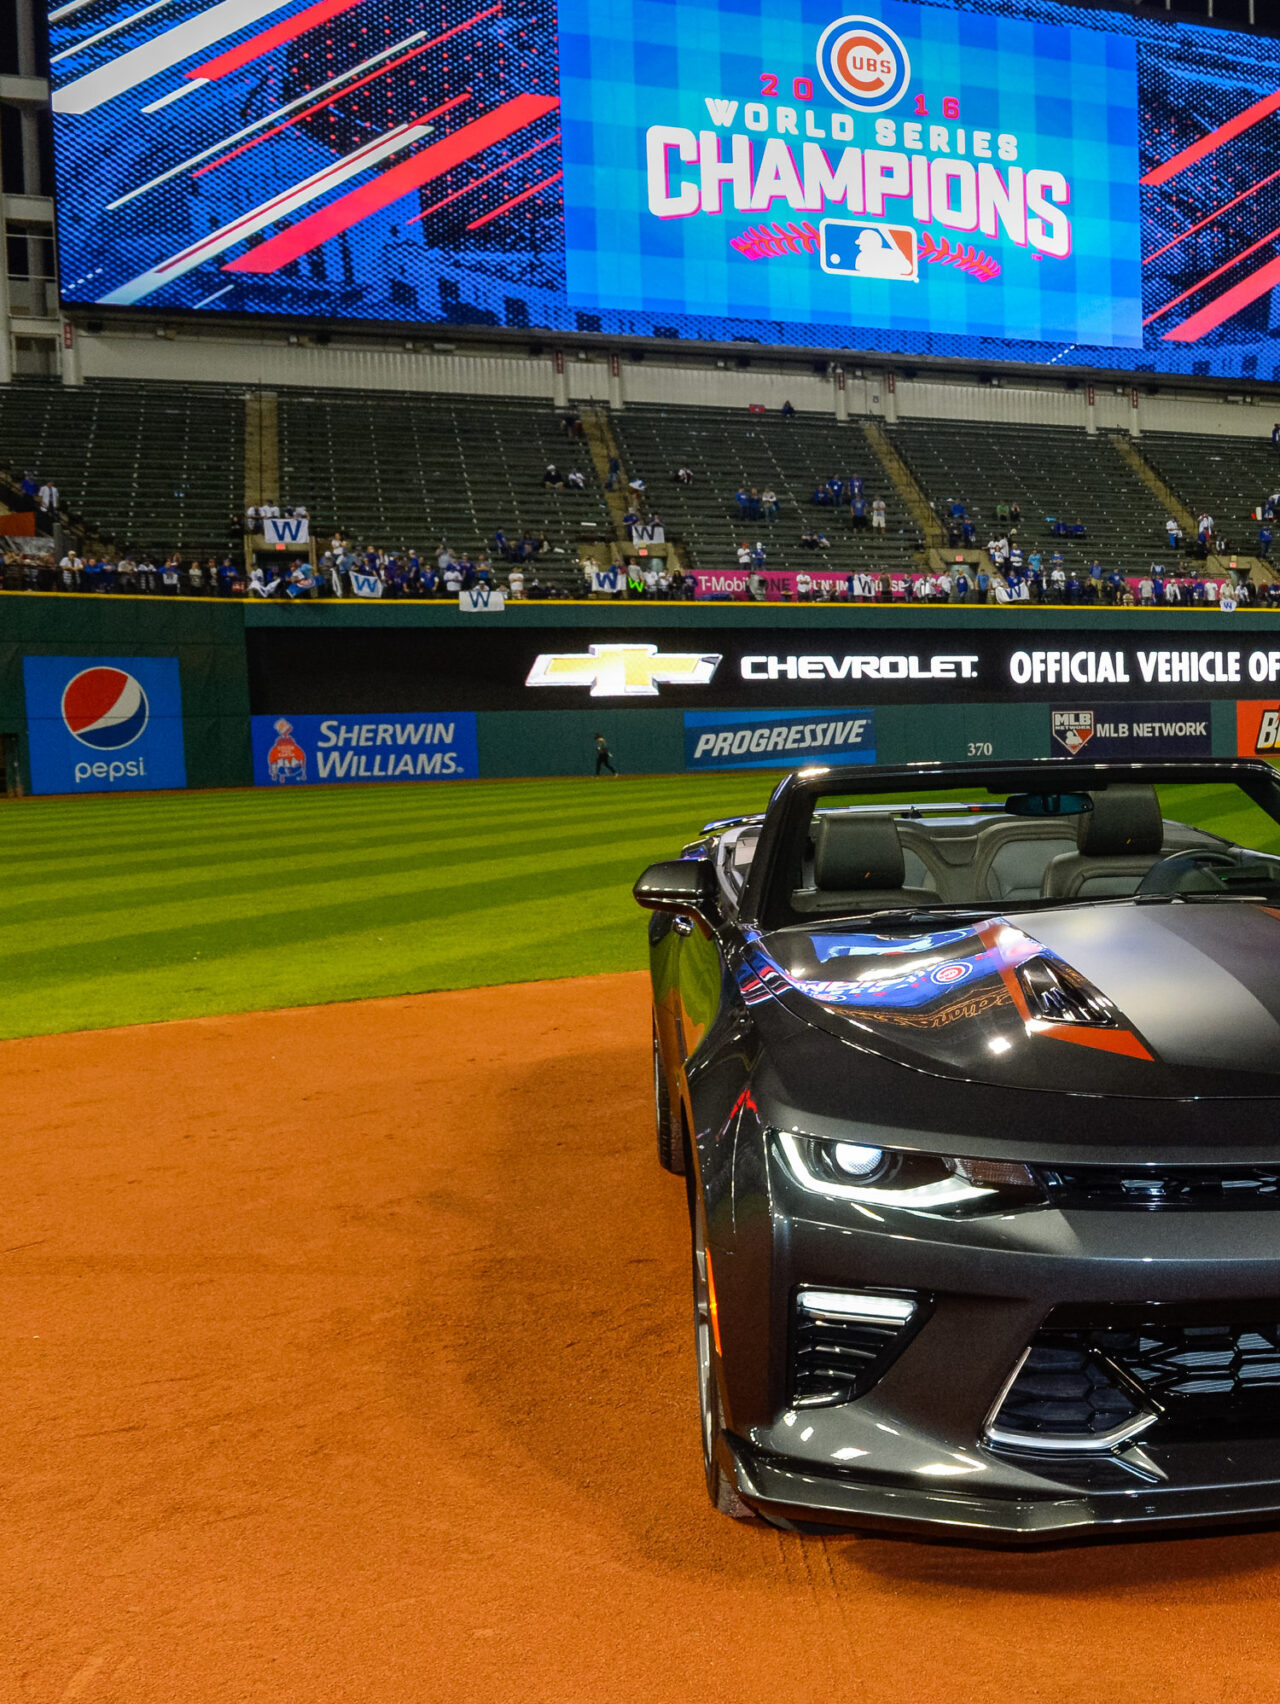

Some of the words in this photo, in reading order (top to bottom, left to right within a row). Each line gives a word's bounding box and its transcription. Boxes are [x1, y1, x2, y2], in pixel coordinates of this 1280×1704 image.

[837, 36, 892, 92] CUBS
[705, 97, 854, 141] WORLD
[875, 118, 1018, 161] SERIES
[646, 124, 1072, 259] CHAMPIONS
[271, 519, 302, 541] W
[634, 526, 655, 541] W
[354, 574, 378, 592] W
[596, 573, 617, 590] W
[628, 577, 644, 593] W
[469, 591, 490, 608] W
[1009, 650, 1130, 684] OFFICIAL
[1137, 650, 1241, 683] VEHICLE
[1054, 713, 1091, 726] MLB
[1096, 723, 1128, 738] MLB
[1133, 722, 1207, 737] NETWORK
[317, 720, 455, 748] SHERWIN
[694, 719, 868, 759] PROGRESSIVE
[967, 742, 993, 756] 370
[75, 756, 145, 783] pepsi
[317, 750, 459, 778] WILLIAMS
